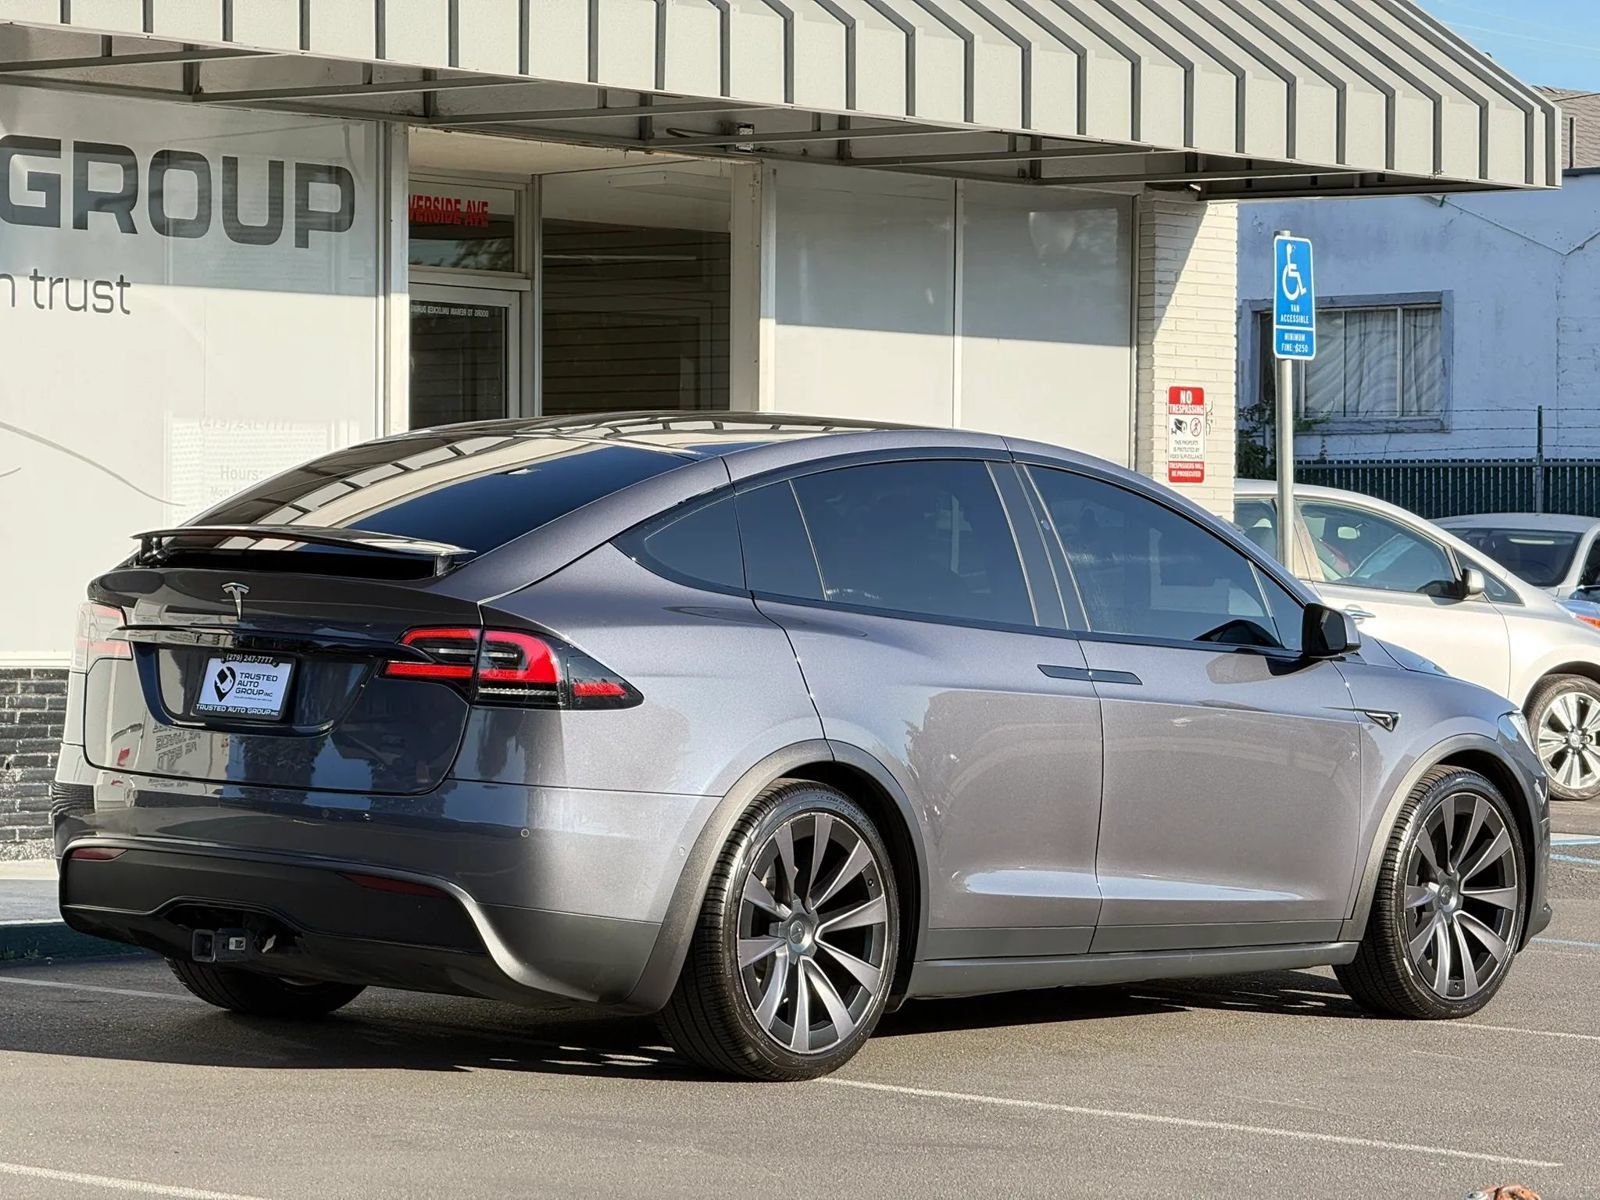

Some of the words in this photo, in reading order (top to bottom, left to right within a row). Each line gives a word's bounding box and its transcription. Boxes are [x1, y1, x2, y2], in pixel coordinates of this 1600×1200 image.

[0, 134, 355, 249] GROUP
[466, 200, 489, 227] AVE
[29, 268, 131, 315] trust
[1290, 304, 1300, 313] VAN
[1280, 314, 1309, 324] ACCESSIBLE
[1281, 343, 1293, 352] FINE
[1180, 389, 1193, 404] NO
[244, 655, 273, 664] 247-7777
[240, 672, 278, 682] TRUSTED
[237, 680, 259, 688] AUTO
[235, 687, 264, 696] GROUP
[196, 703, 227, 712] TRUSTED
[227, 706, 245, 714] AUTO
